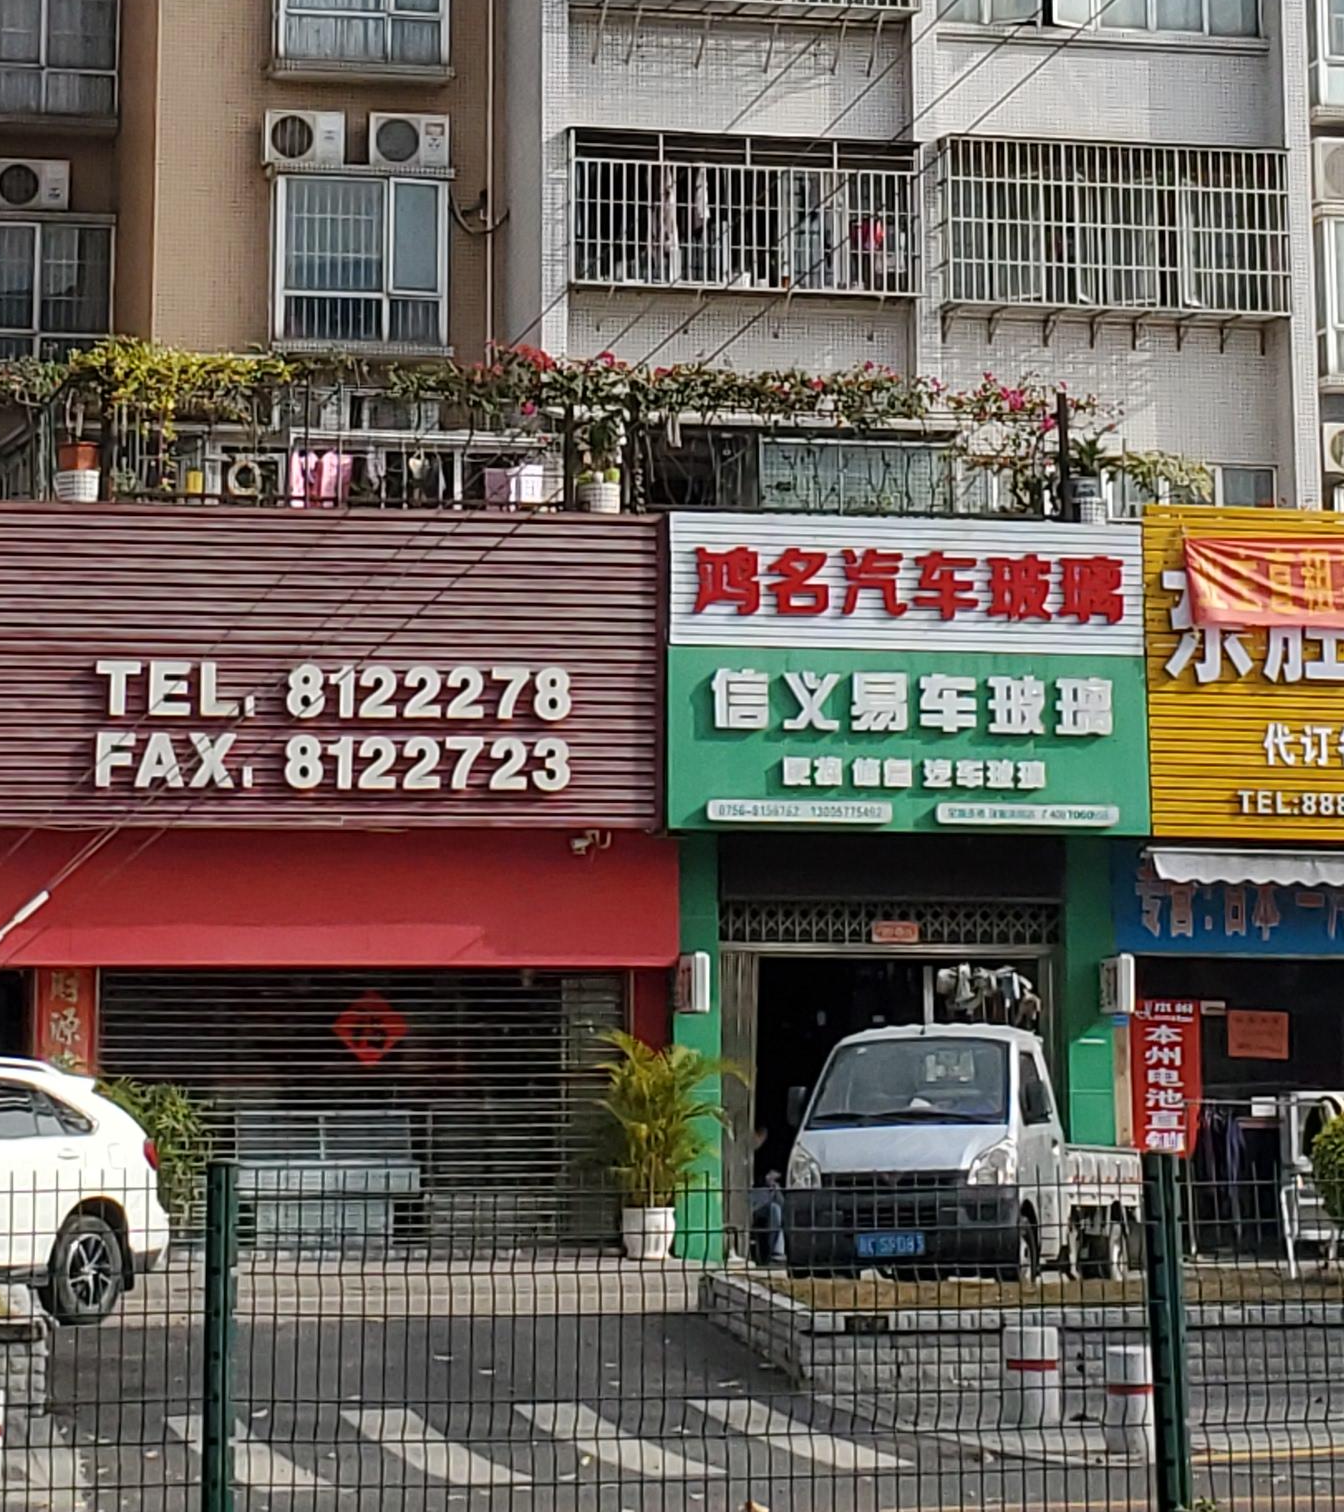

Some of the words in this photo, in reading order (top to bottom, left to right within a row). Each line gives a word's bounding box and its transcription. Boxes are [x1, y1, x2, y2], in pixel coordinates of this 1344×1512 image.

[692, 545, 1126, 625] 鸿名汽车玻璃
[286, 665, 573, 721] 8122278
[711, 668, 1115, 737] 信义易车玻璃
[284, 734, 572, 792] 8122723
